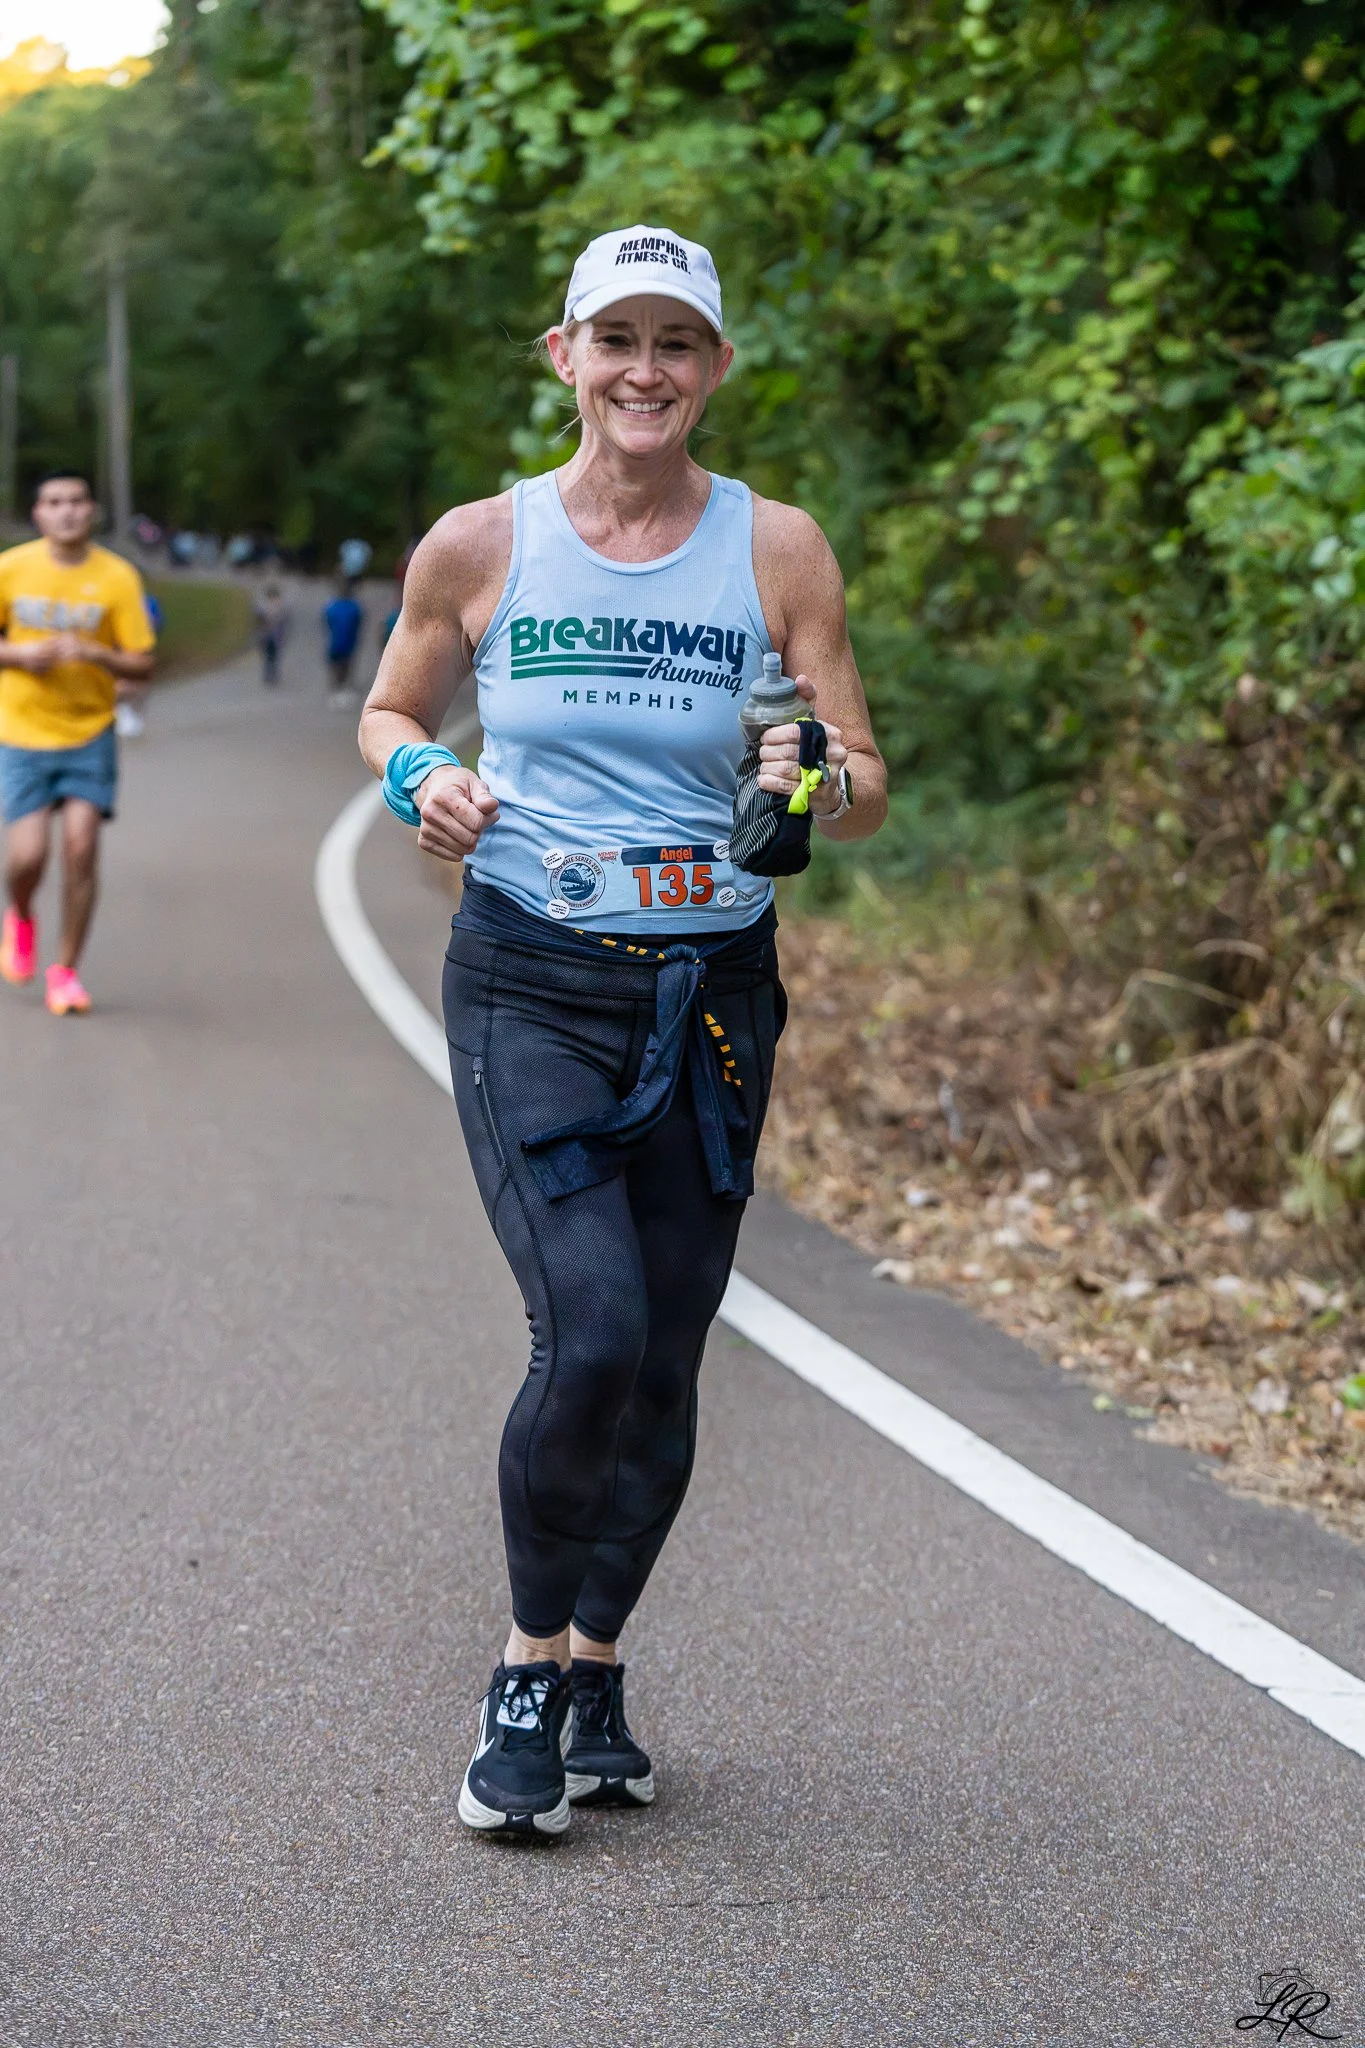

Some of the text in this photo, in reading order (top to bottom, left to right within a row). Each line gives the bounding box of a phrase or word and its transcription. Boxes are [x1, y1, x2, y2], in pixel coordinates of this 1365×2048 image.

[620, 237, 688, 261] MEMPHIS
[615, 251, 692, 275] FITNESS CO.
[647, 657, 744, 698] Running
[563, 690, 693, 711] MEMPHIS
[660, 847, 692, 861] Angel
[633, 864, 715, 907] 135
